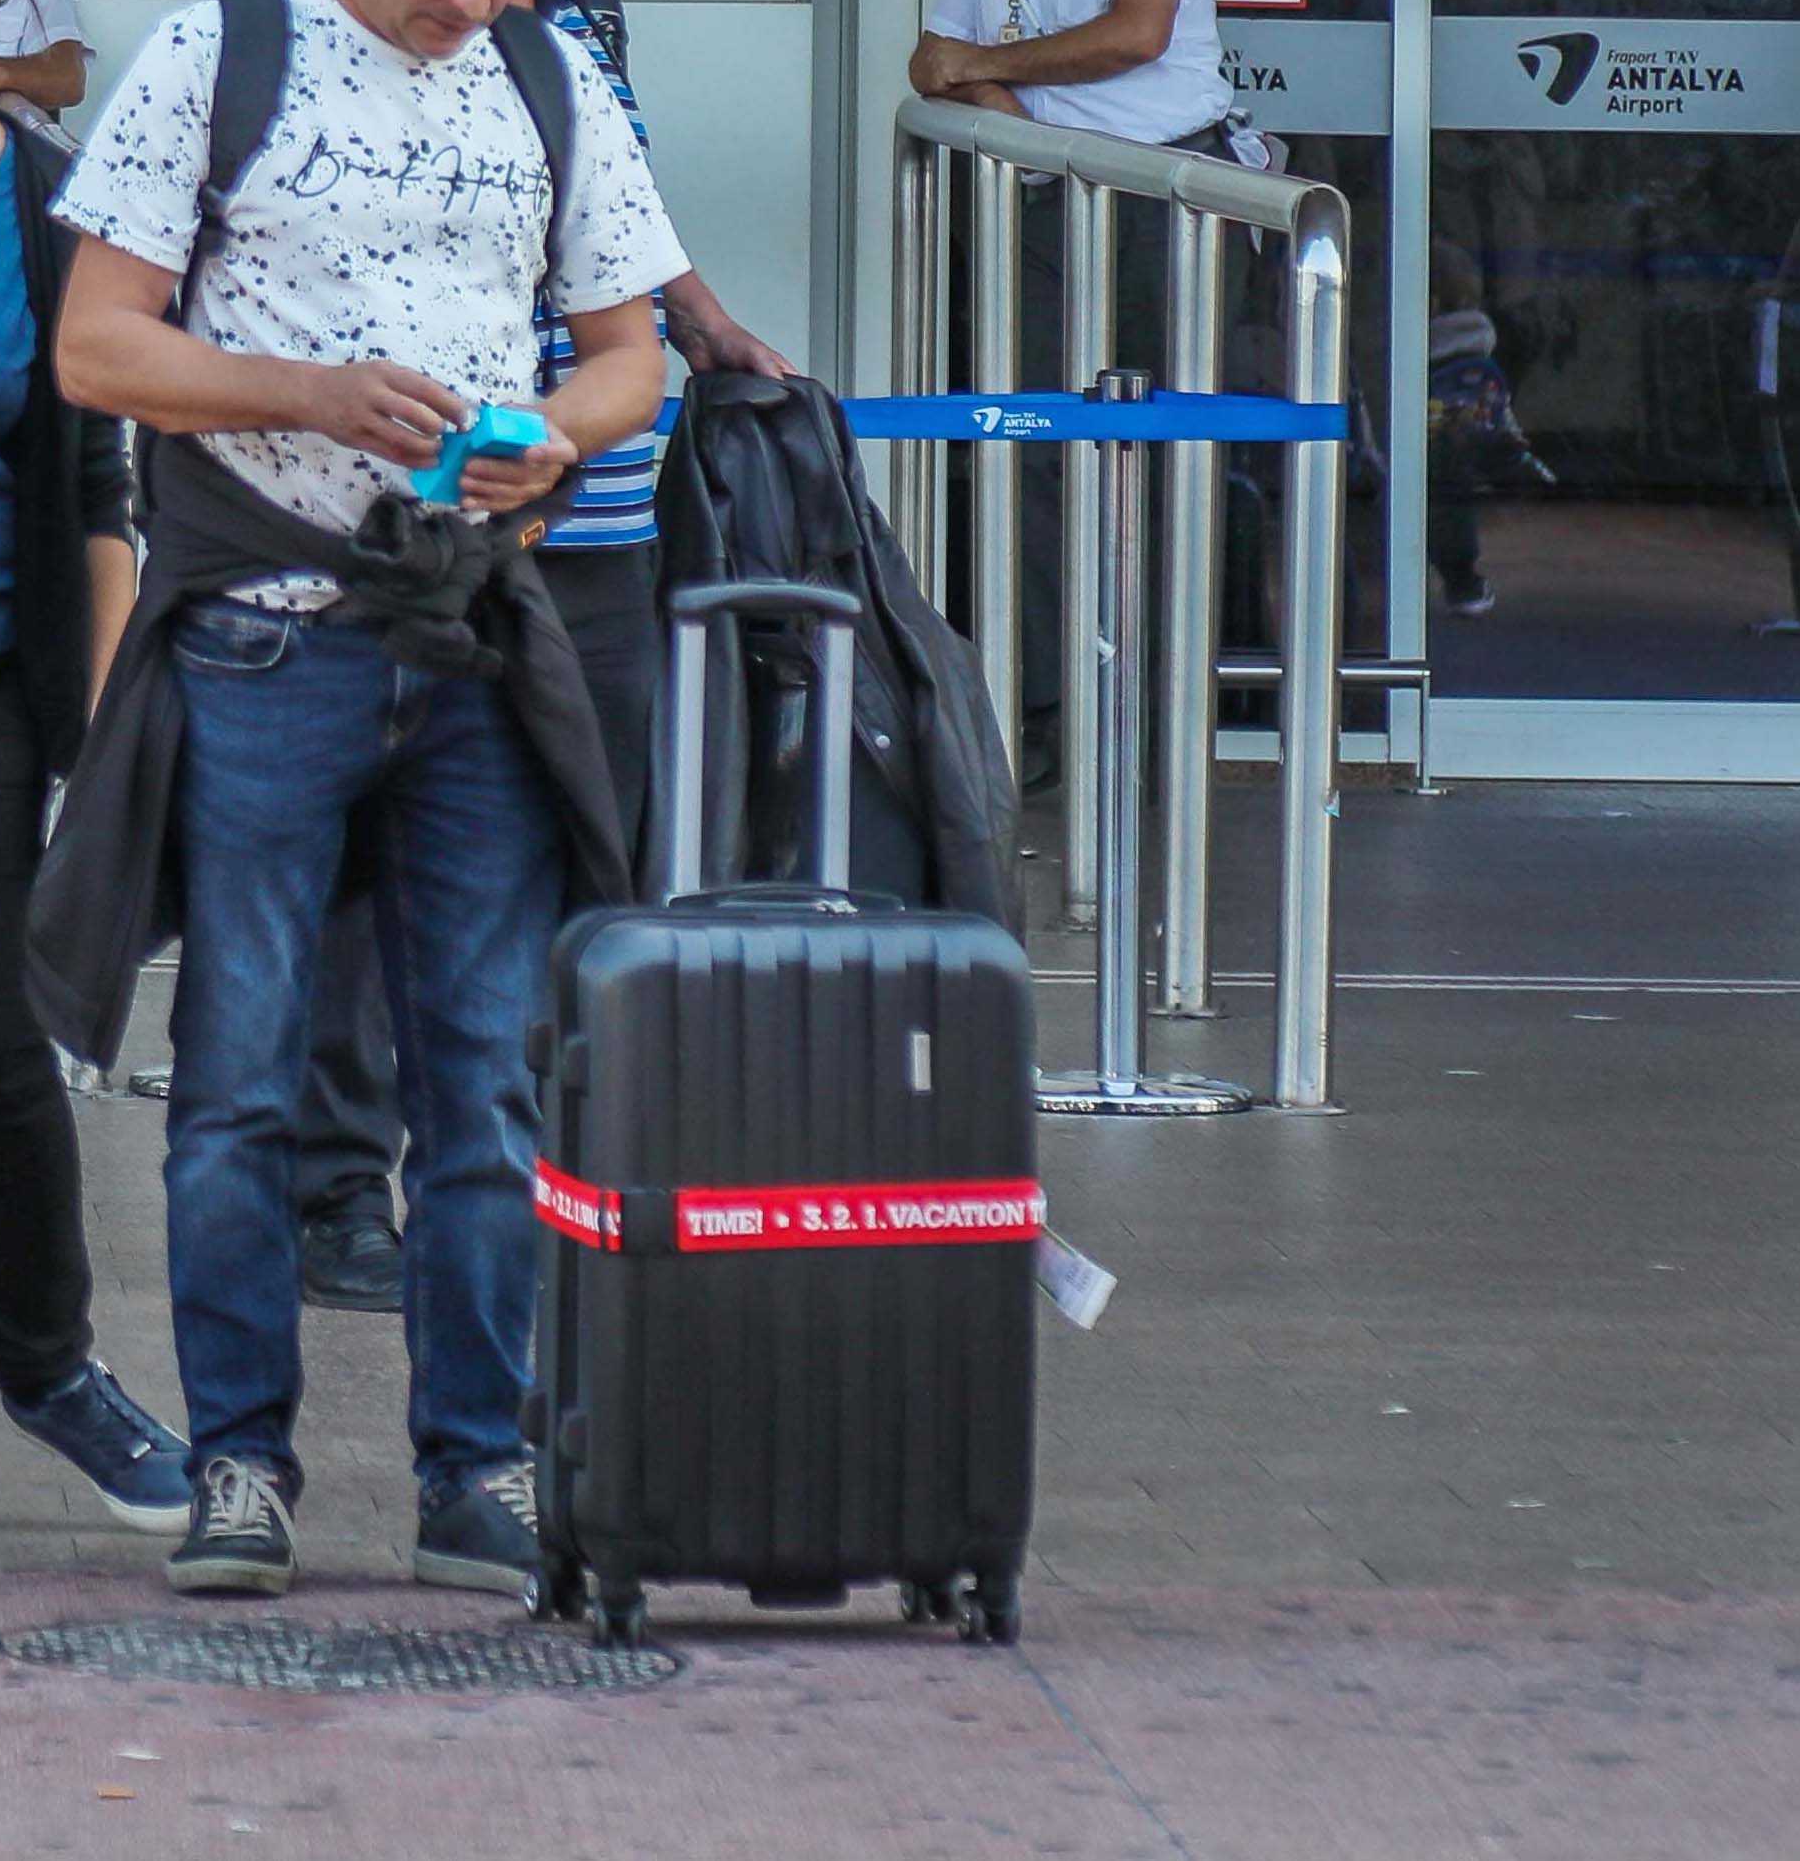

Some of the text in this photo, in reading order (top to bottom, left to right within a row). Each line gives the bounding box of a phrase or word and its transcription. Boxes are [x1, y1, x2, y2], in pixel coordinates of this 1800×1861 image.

[1221, 49, 1243, 63] AV
[1607, 50, 1700, 66] Fraport TAV
[1607, 67, 1745, 92] ANTALYA
[1607, 95, 1683, 117] Airport
[686, 1208, 763, 1236] TIME!
